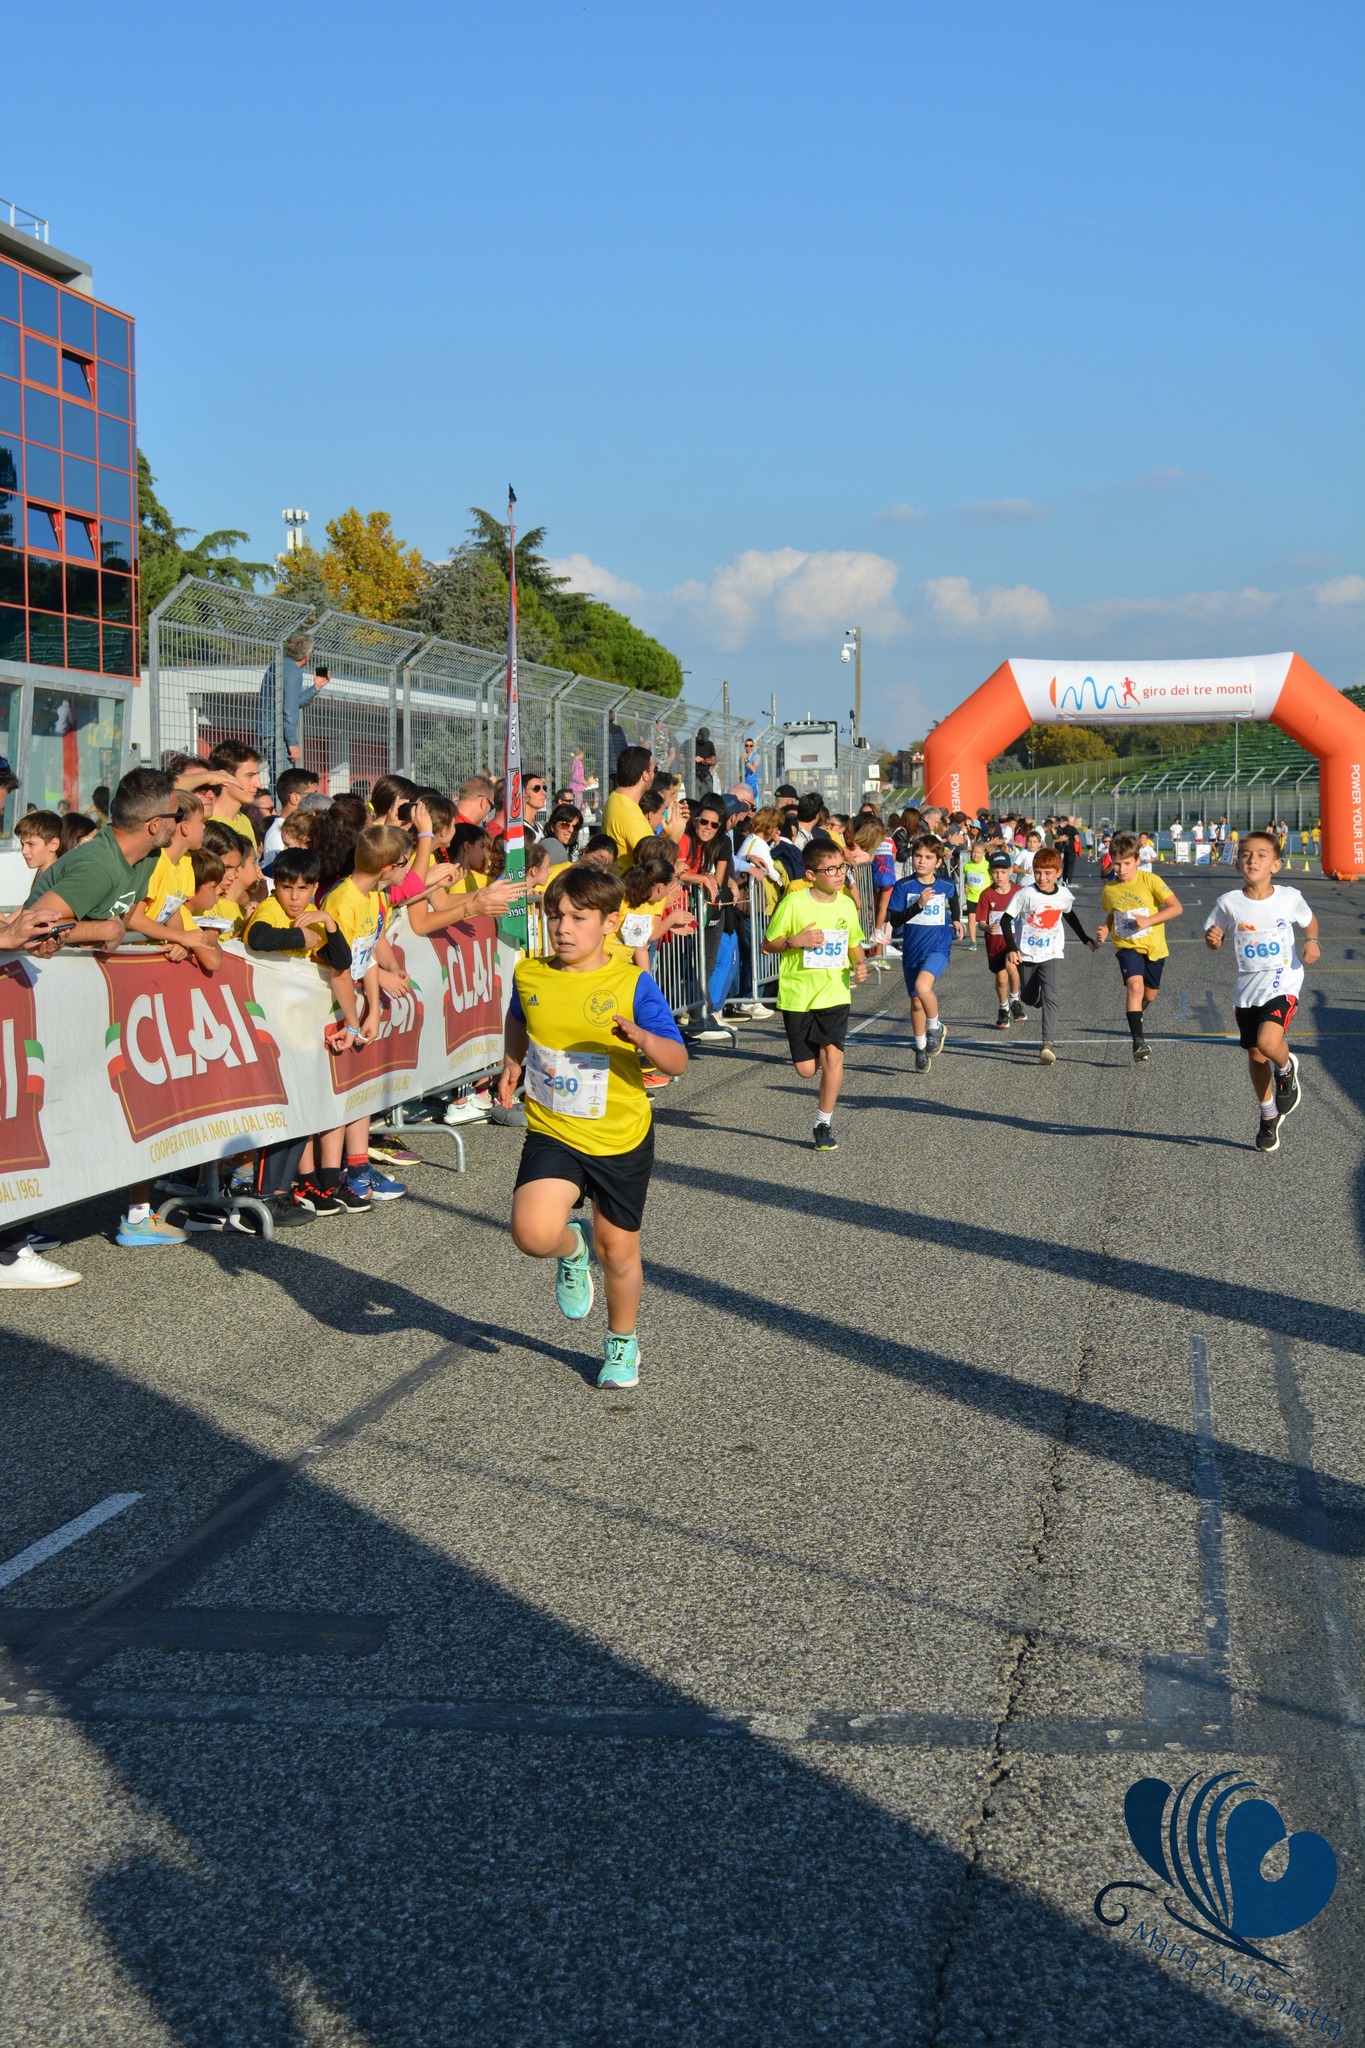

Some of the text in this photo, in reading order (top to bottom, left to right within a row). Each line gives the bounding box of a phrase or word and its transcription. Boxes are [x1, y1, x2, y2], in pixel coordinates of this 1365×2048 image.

[1143, 683, 1252, 699] giro dei tre monti
[950, 773, 961, 813] POWER
[1350, 764, 1364, 864] POWER YOUR LIFE
[923, 904, 940, 916] 58
[1027, 936, 1051, 948] 641
[1244, 941, 1280, 959] 669
[446, 937, 492, 1014] CLAI
[126, 984, 259, 1085] CLAI
[150, 1111, 288, 1163] COOPERATIVA A IMOLA DAL 1962
[16, 1177, 43, 1200] 1962
